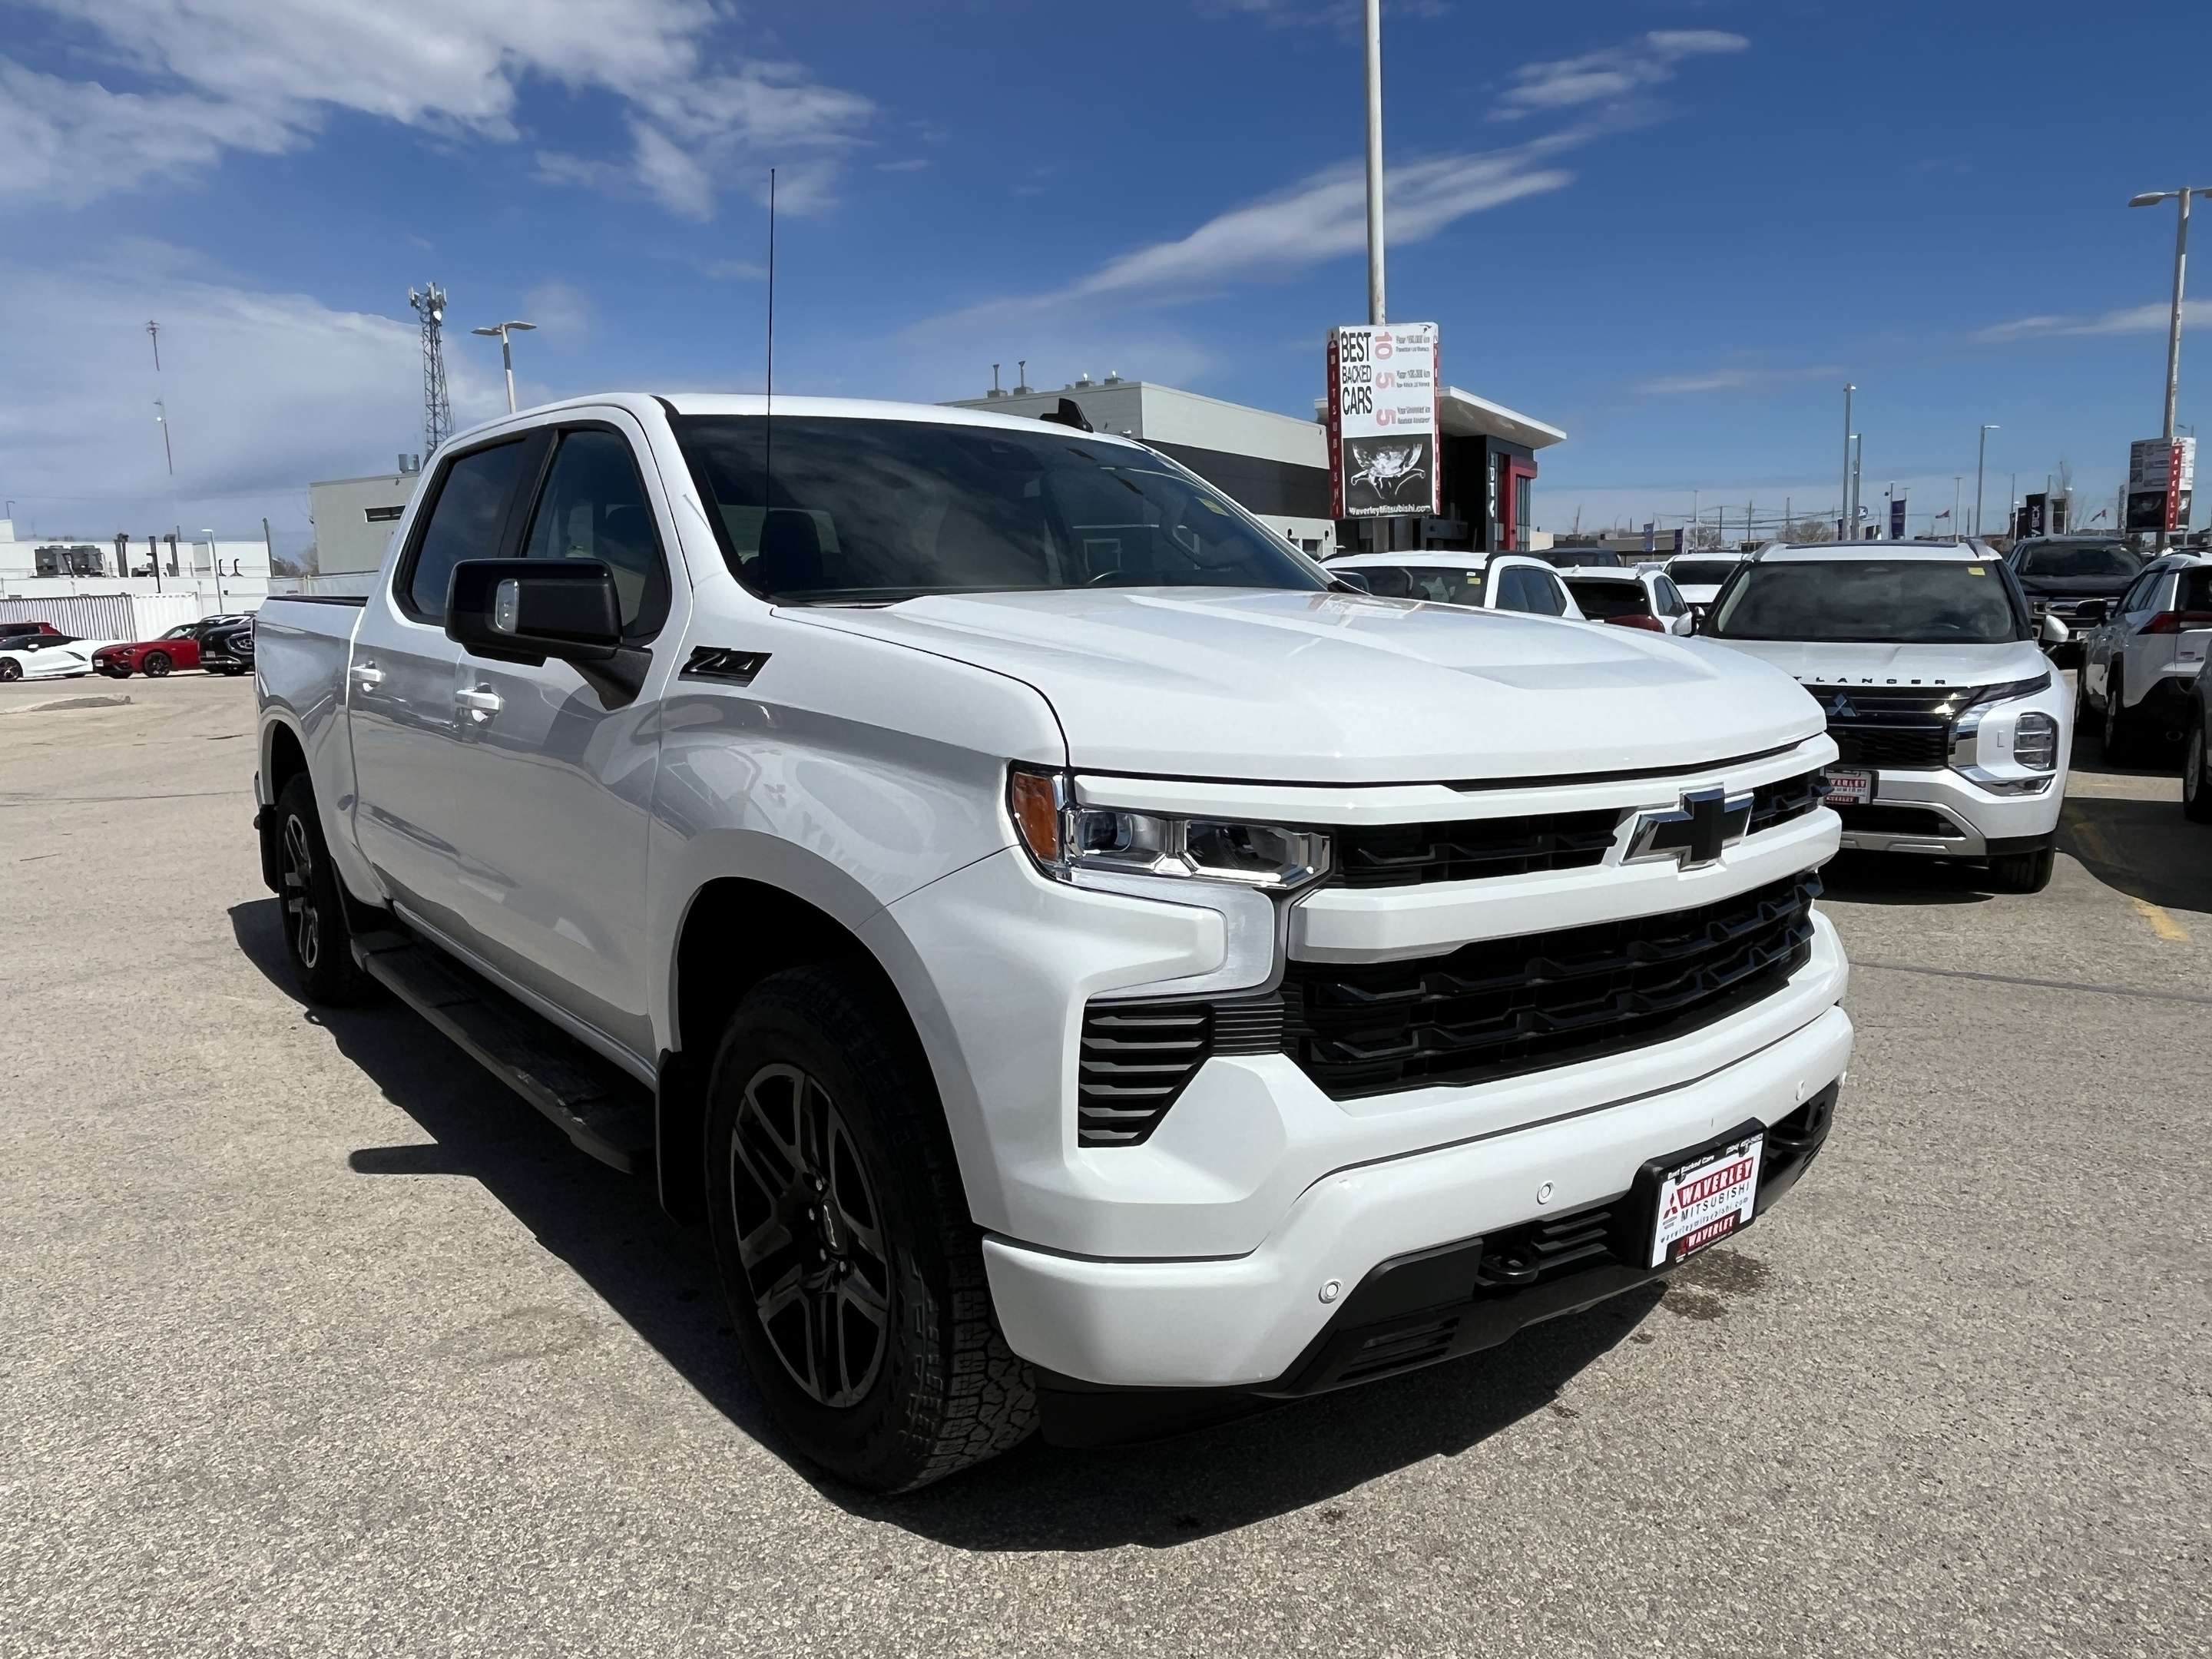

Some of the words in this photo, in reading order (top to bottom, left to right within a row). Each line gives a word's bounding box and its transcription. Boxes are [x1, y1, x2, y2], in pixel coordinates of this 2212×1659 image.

[1341, 331, 1371, 363] BEST
[1375, 331, 1393, 360] 10
[1342, 365, 1372, 384] BACKED
[1376, 372, 1396, 389] 5
[1342, 386, 1373, 416] CARS
[1376, 409, 1396, 426] 5
[1682, 1161, 1753, 1206] WAVERLEY
[1681, 1182, 1750, 1221] MITSUBISHI
